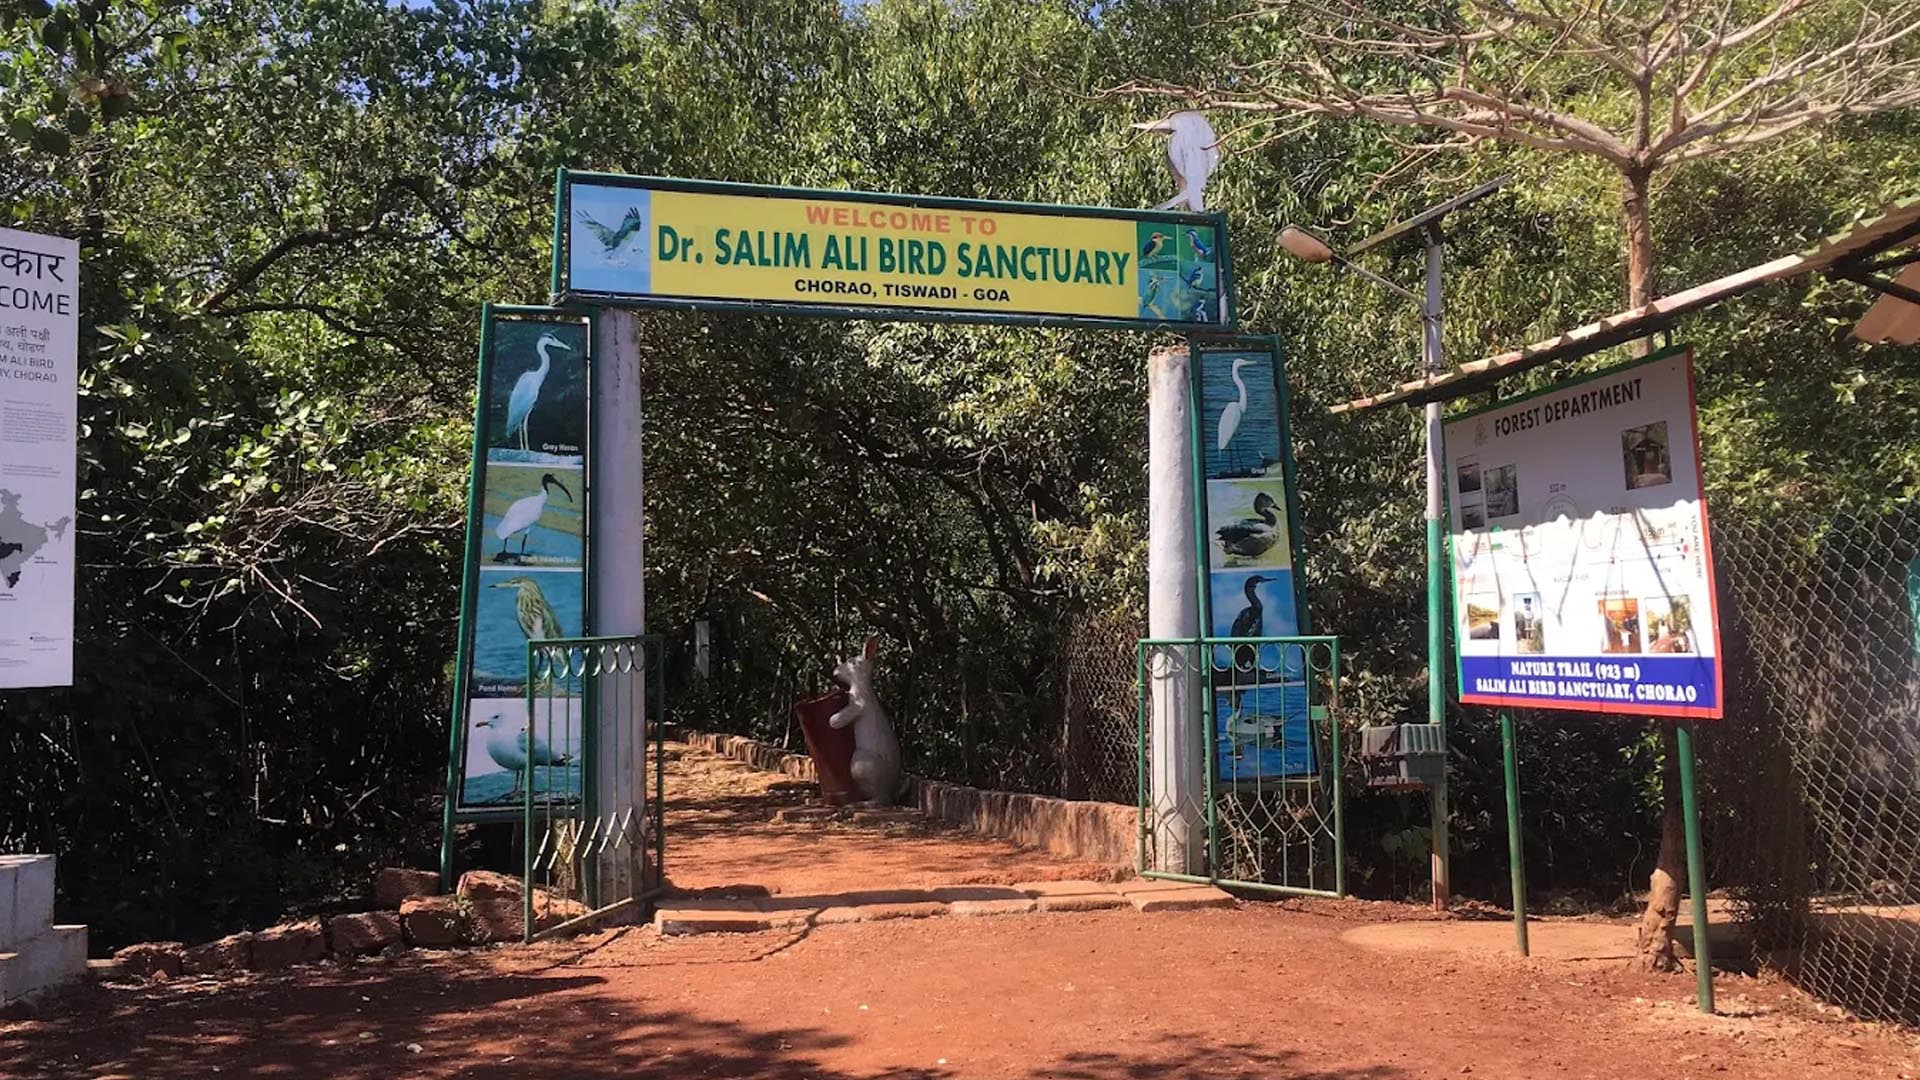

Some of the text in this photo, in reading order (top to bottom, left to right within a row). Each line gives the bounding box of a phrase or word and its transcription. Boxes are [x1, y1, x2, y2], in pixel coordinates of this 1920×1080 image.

[806, 205, 997, 235] WELCOME TO
[657, 225, 1131, 286] Dr. SALIM ALI BIRD SANCTUARY
[794, 278, 877, 298] CHORAO,
[883, 283, 958, 300] TISWADI
[973, 287, 1011, 302] GOA
[10, 355, 27, 367] ALI
[29, 357, 55, 369] BIRD
[14, 369, 58, 384] CHORAO
[1494, 378, 1643, 438] FOREST DEPARTMENT
[1510, 661, 1641, 681] NATURE TRAIL (923 m)
[1476, 678, 1698, 703] SALIM ALI BIRD SANCTUARY, CHORAO
